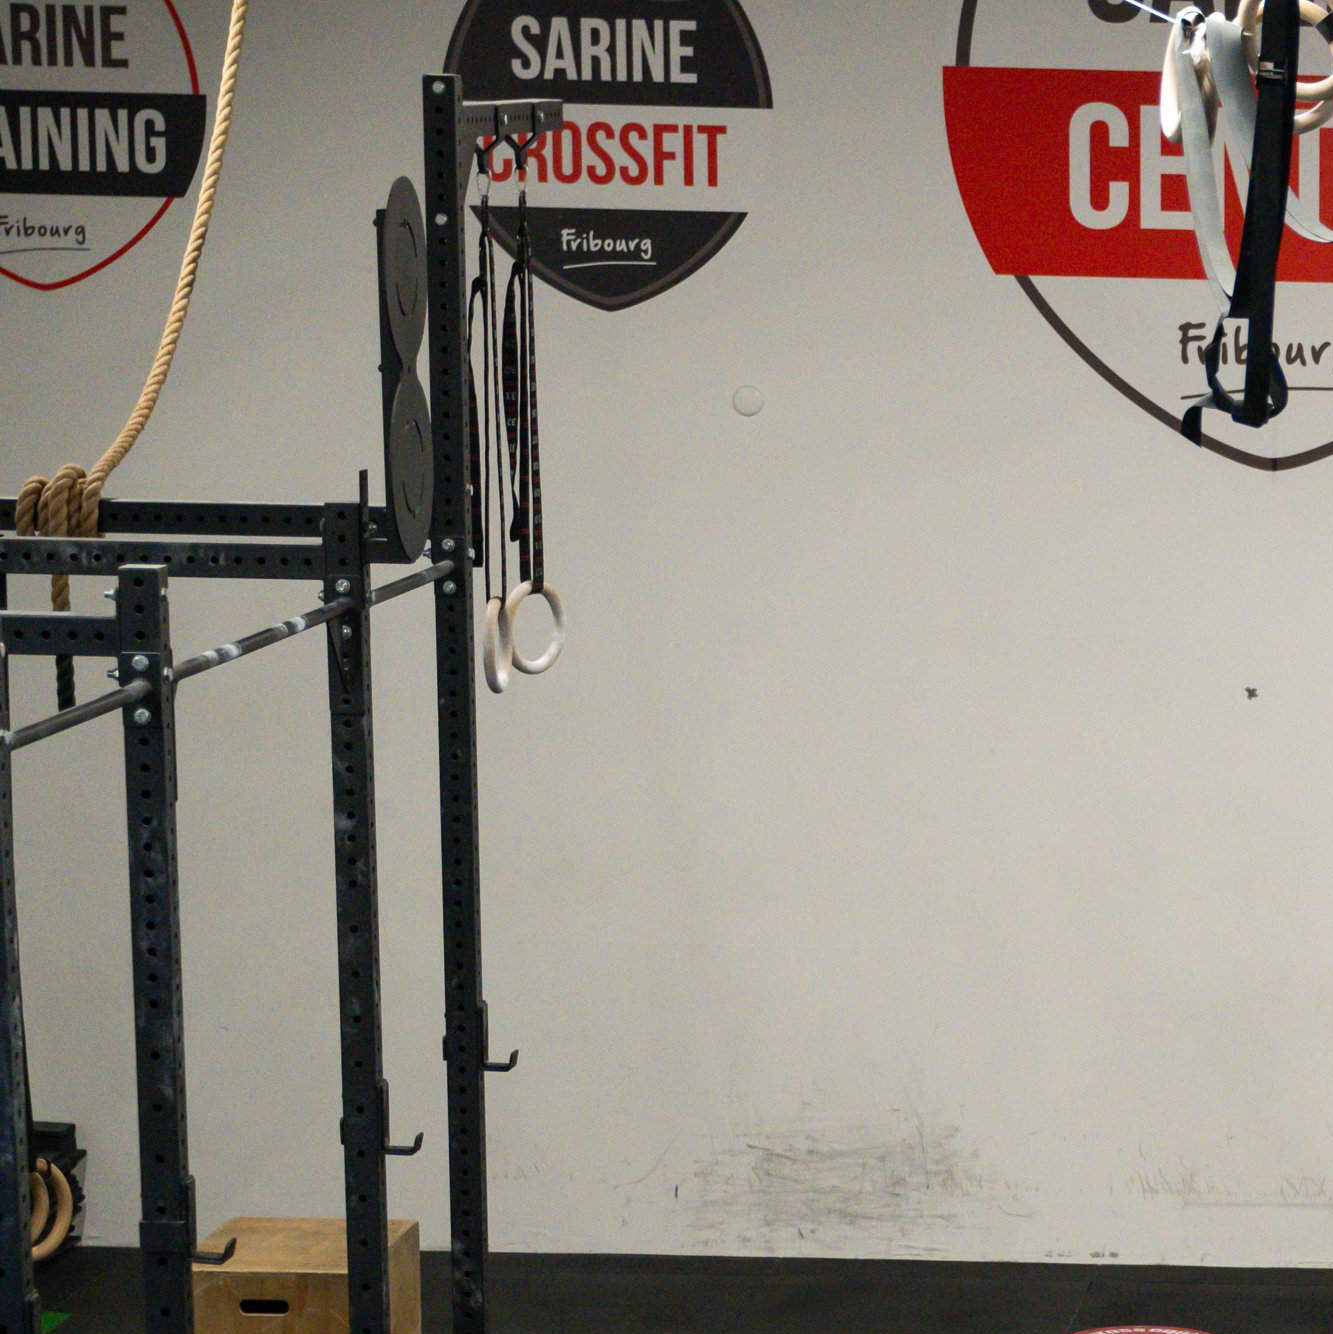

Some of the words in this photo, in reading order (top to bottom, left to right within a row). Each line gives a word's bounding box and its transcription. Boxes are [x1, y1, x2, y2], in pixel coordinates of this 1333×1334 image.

[0, 3, 129, 69] RINE
[511, 15, 698, 84] SARINE
[560, 228, 653, 259] Fribourg
